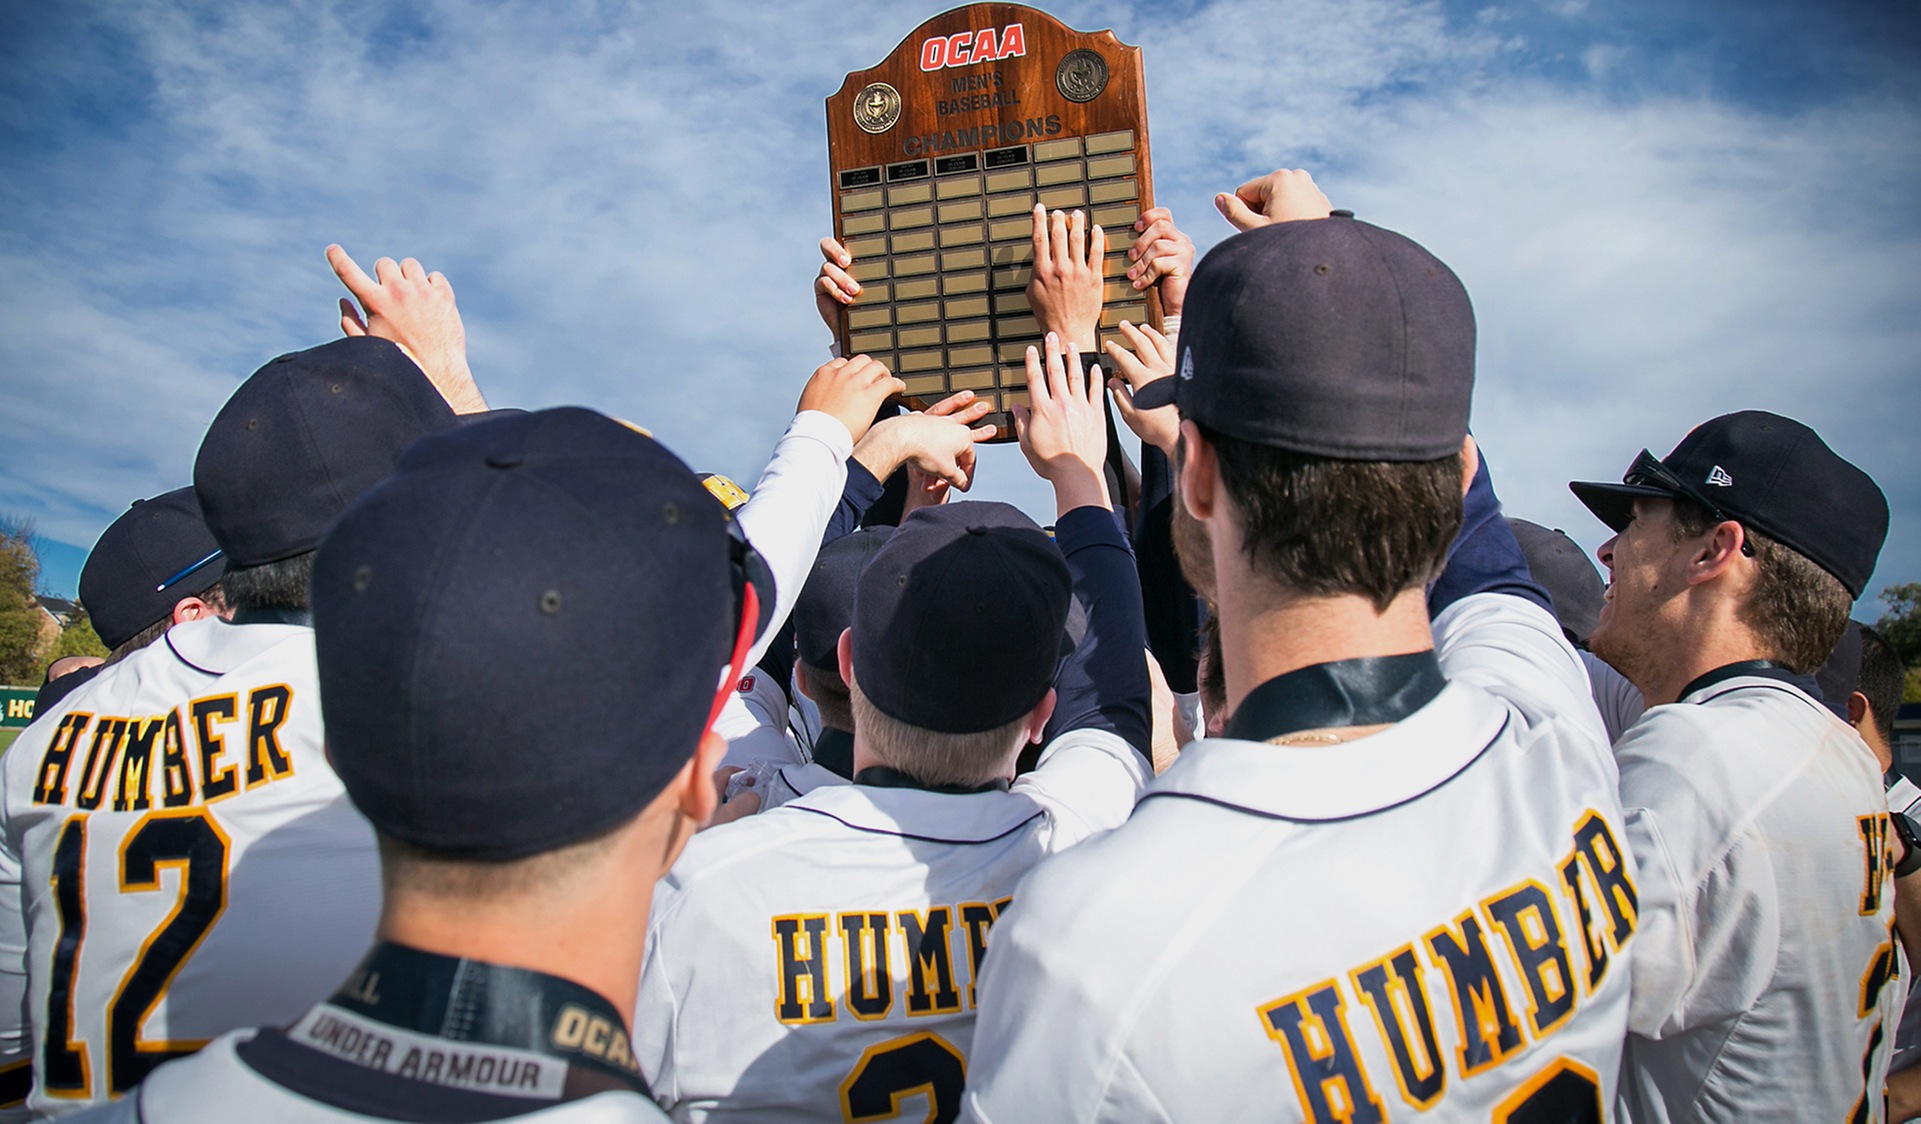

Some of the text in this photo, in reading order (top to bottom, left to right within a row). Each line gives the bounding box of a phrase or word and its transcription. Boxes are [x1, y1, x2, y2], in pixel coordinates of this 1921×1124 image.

[920, 23, 1027, 72] OCAA
[938, 89, 1021, 116] BASEBALL
[951, 71, 1003, 94] MEN'S
[903, 115, 1062, 156] CHAMPIONS
[33, 683, 295, 811] HUMBER
[44, 805, 232, 1101] 12
[1256, 808, 1639, 1124] HUMBER
[309, 1013, 541, 1091] UNDER ARMOUR
[554, 1005, 641, 1074] OCA
